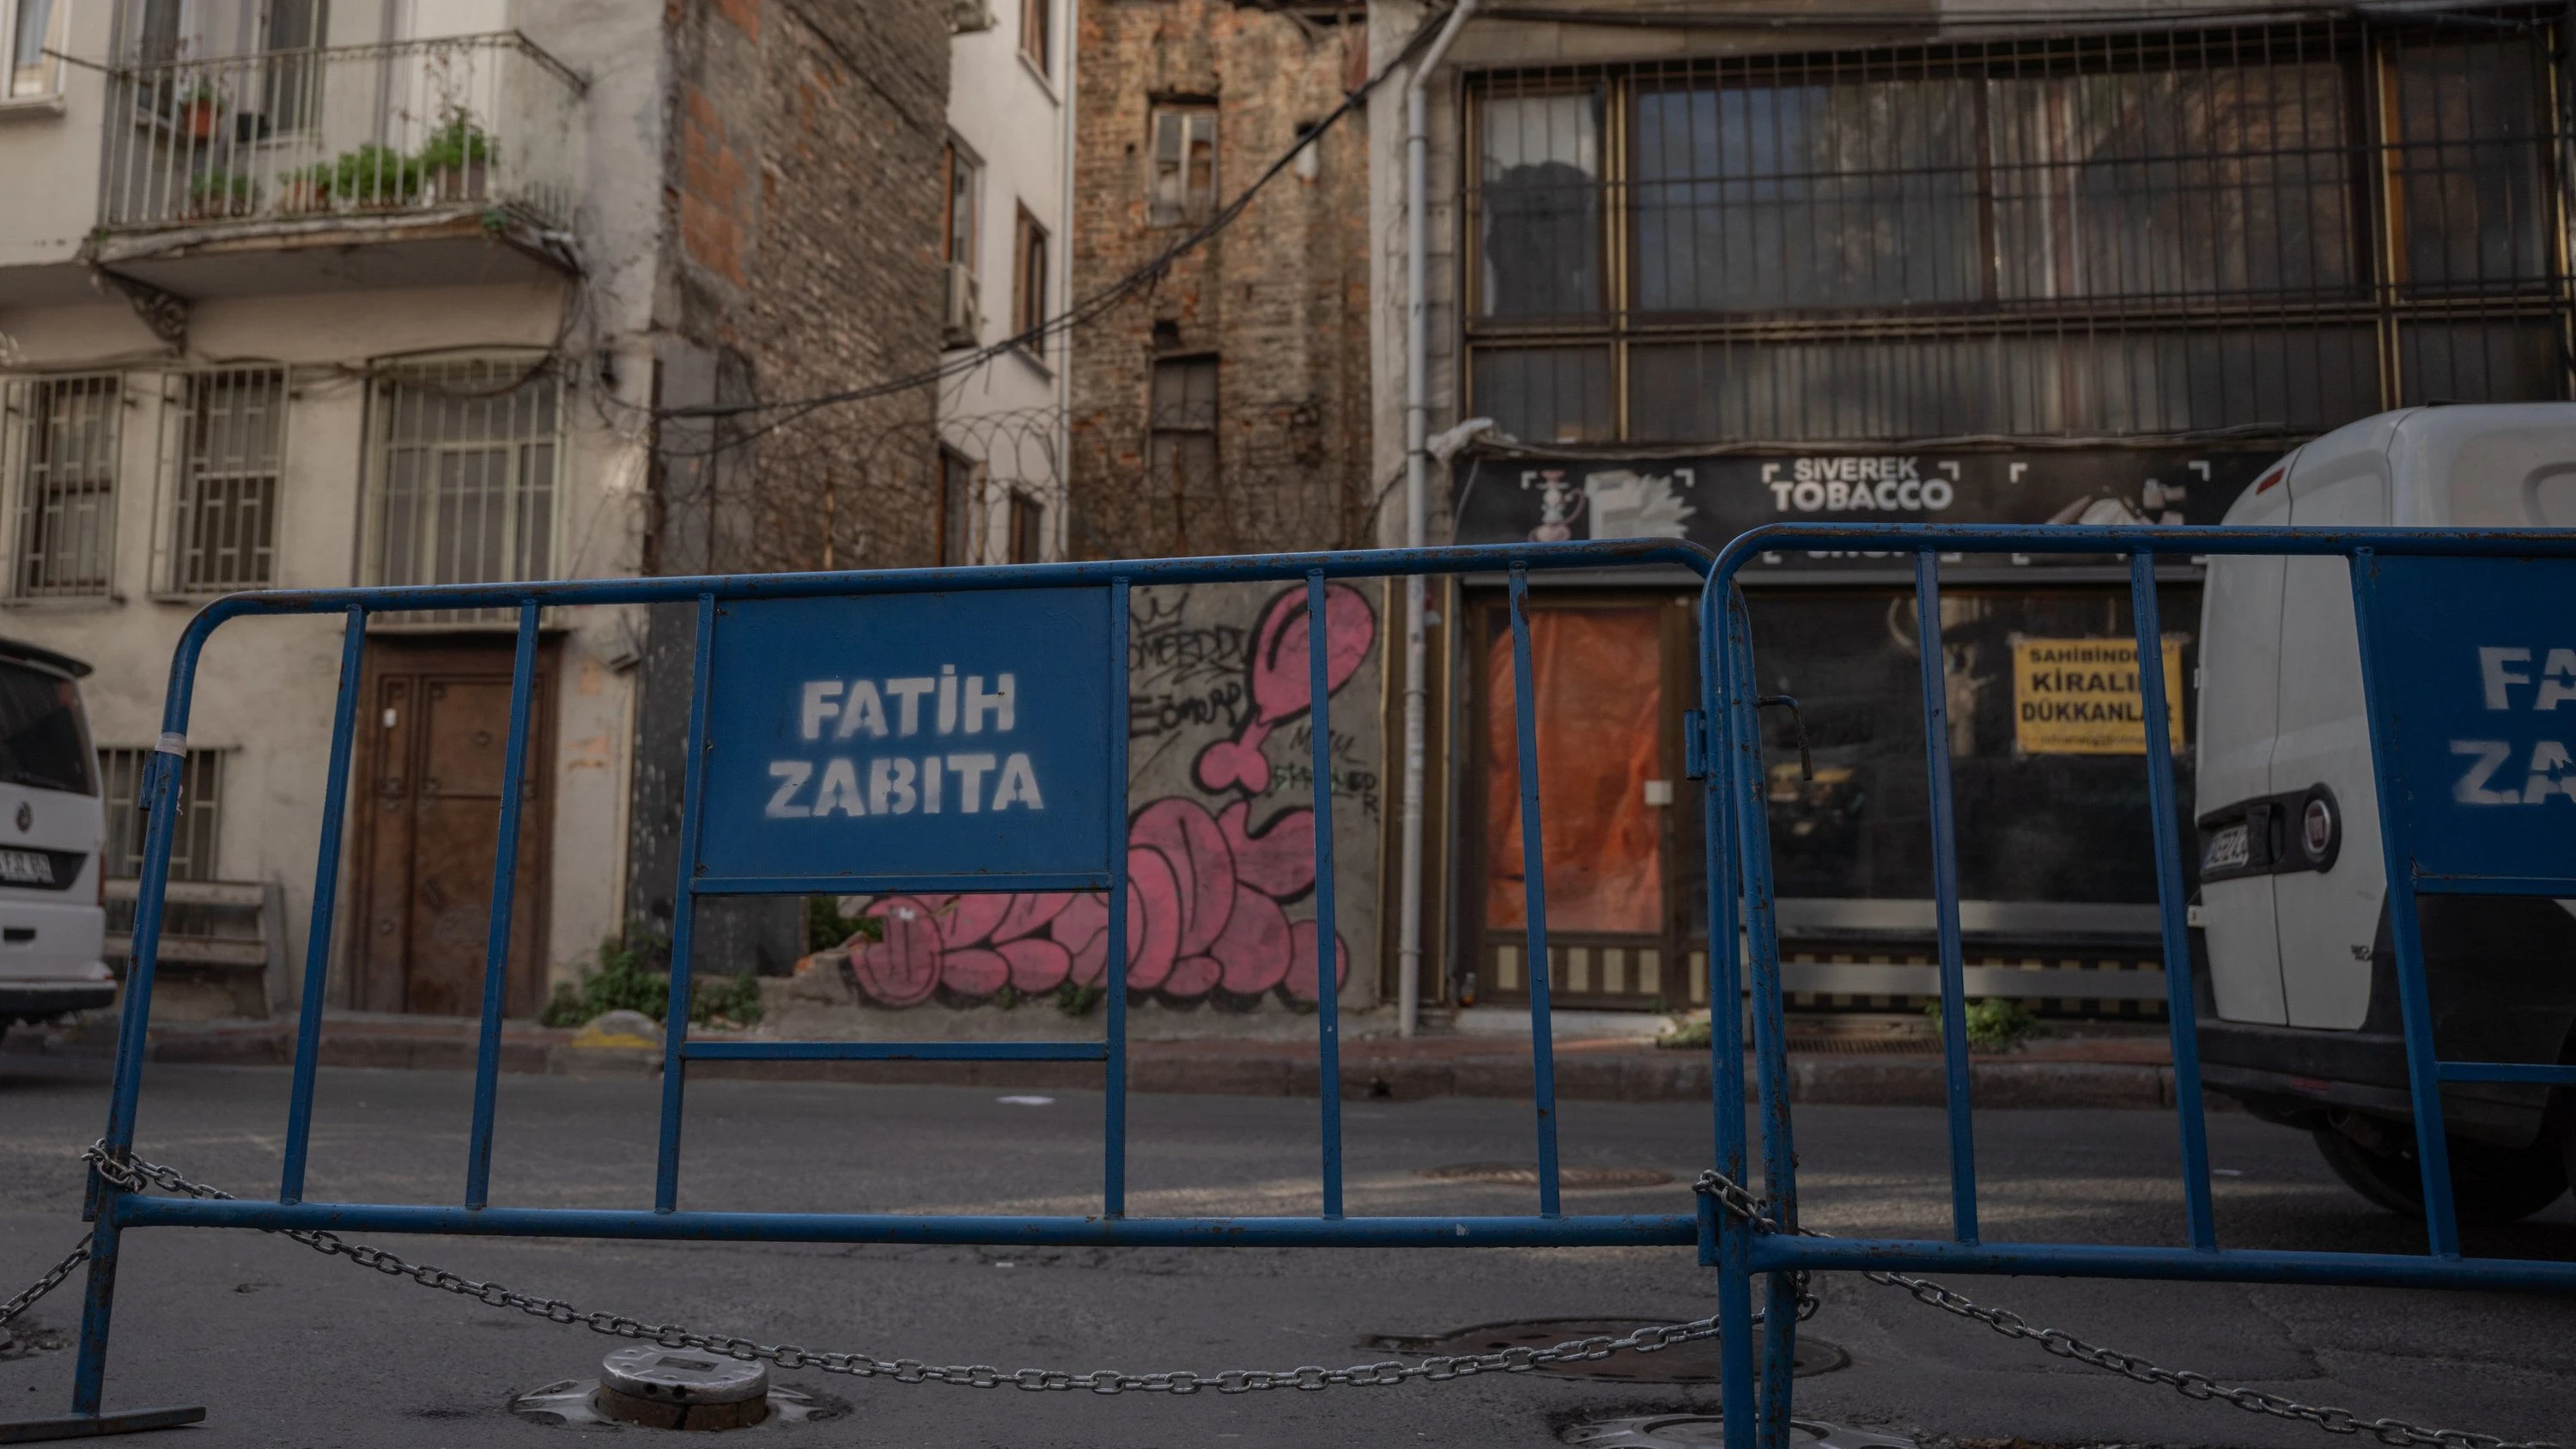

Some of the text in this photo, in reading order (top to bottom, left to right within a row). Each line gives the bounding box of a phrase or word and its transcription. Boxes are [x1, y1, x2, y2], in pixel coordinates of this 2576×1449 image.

[1770, 479, 1954, 512] TOBACCO
[2029, 646, 2141, 664] SAHİBİND
[2032, 667, 2142, 692] KİRALI
[801, 664, 1015, 740] FATİH
[2021, 698, 2172, 722] DÜKKANL
[765, 752, 1044, 819] ZABITA
